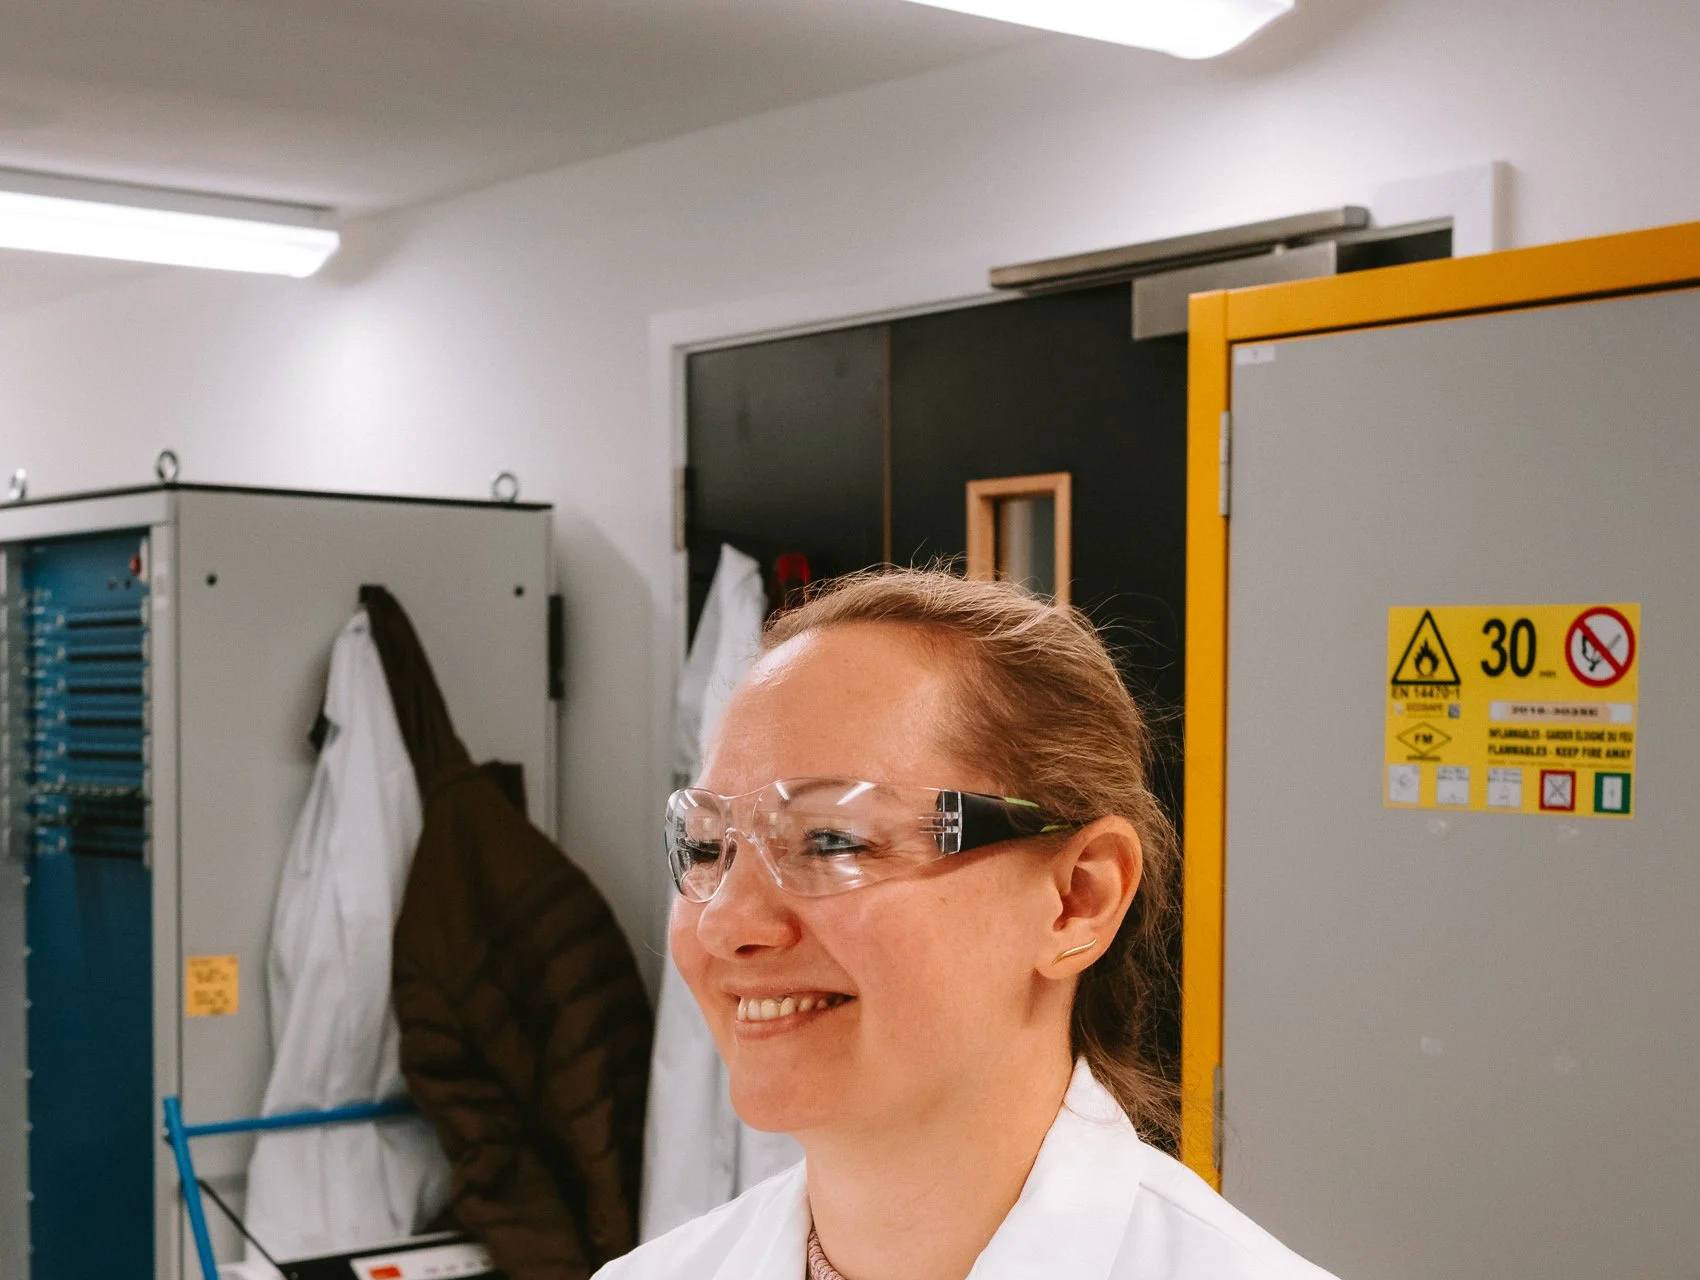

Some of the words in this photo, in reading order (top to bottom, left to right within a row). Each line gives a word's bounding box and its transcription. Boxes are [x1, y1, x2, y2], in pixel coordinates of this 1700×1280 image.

[1481, 618, 1537, 678] 30
[1487, 744, 1547, 757] FLAMMABLES
[1555, 746, 1579, 758] KEEP
[1581, 747, 1602, 759] FIRE
[1604, 748, 1632, 759] AWAY
